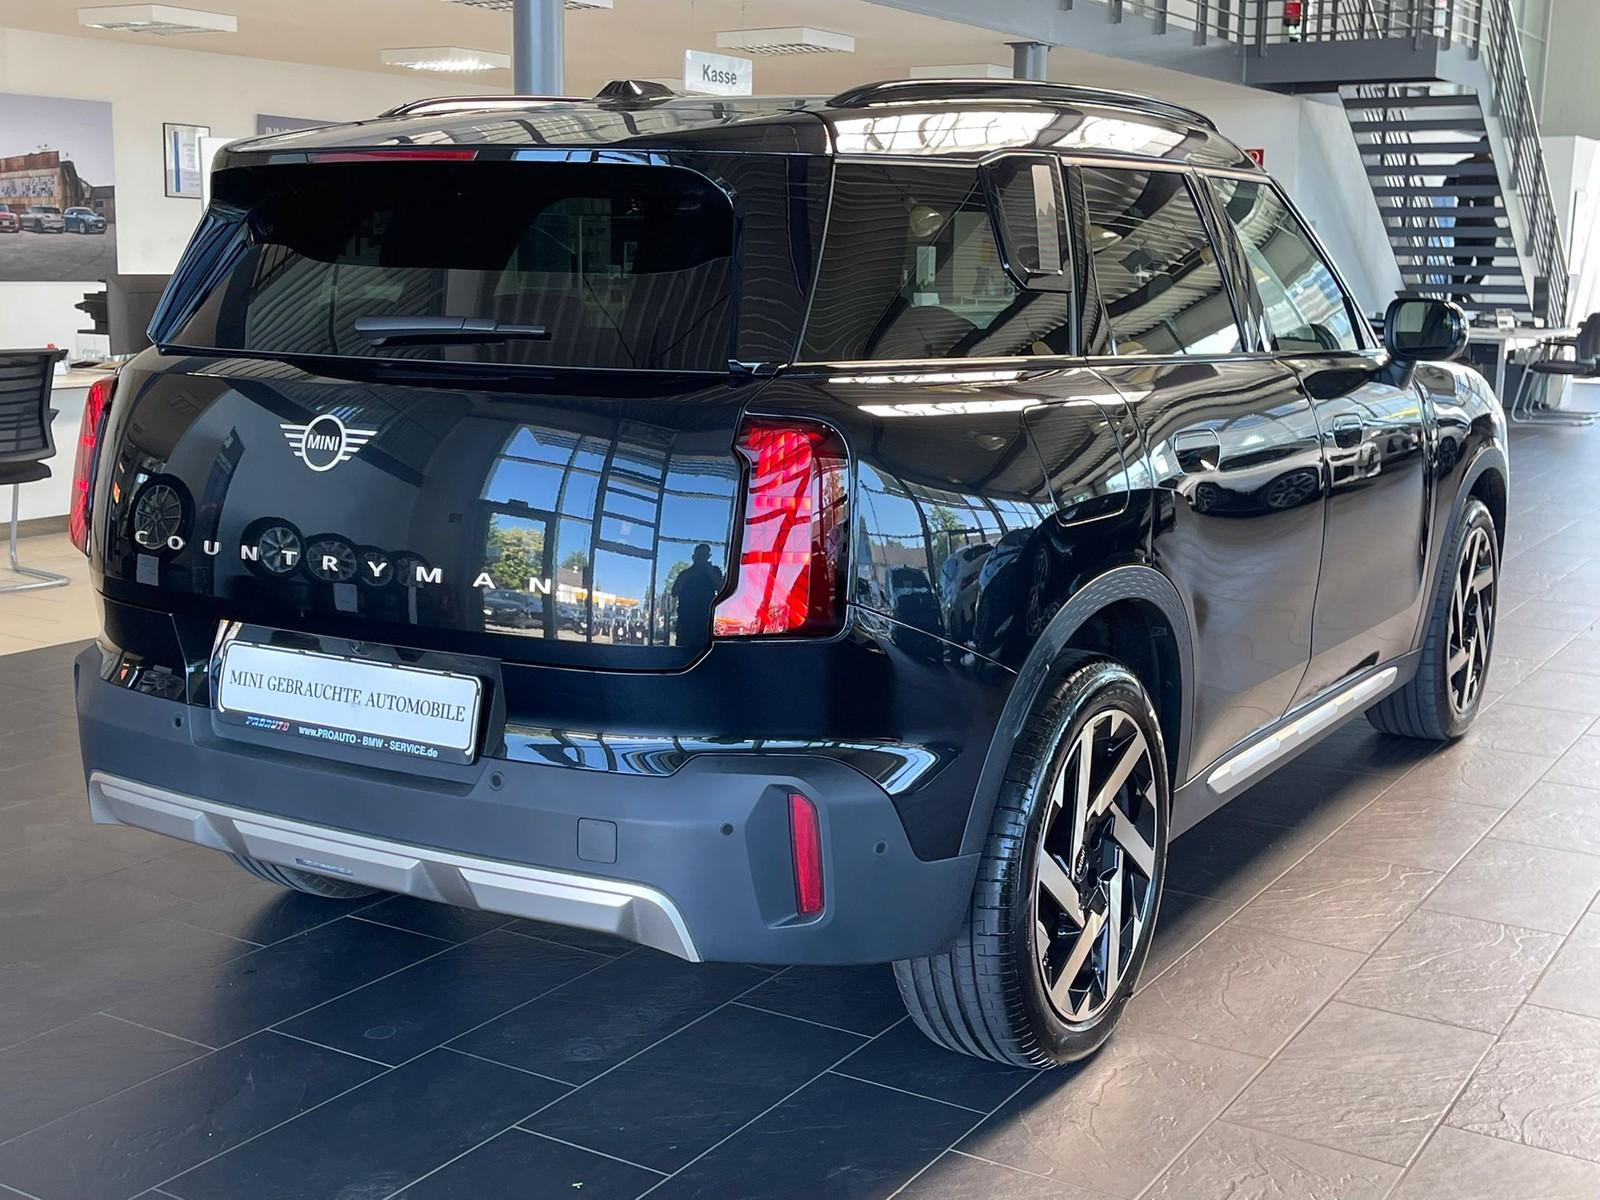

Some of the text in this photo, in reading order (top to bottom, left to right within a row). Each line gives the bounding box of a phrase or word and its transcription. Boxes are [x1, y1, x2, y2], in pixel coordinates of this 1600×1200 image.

[702, 63, 737, 86] Kasse
[307, 434, 340, 452] MINI
[134, 530, 551, 594] COUNTRYMAN
[229, 670, 466, 722] MINI GEBRAUCHTE AUTOMOBILE
[298, 726, 356, 743] www.PROAUTO
[362, 735, 384, 748] BMW
[389, 741, 438, 758] SERVICE.de
